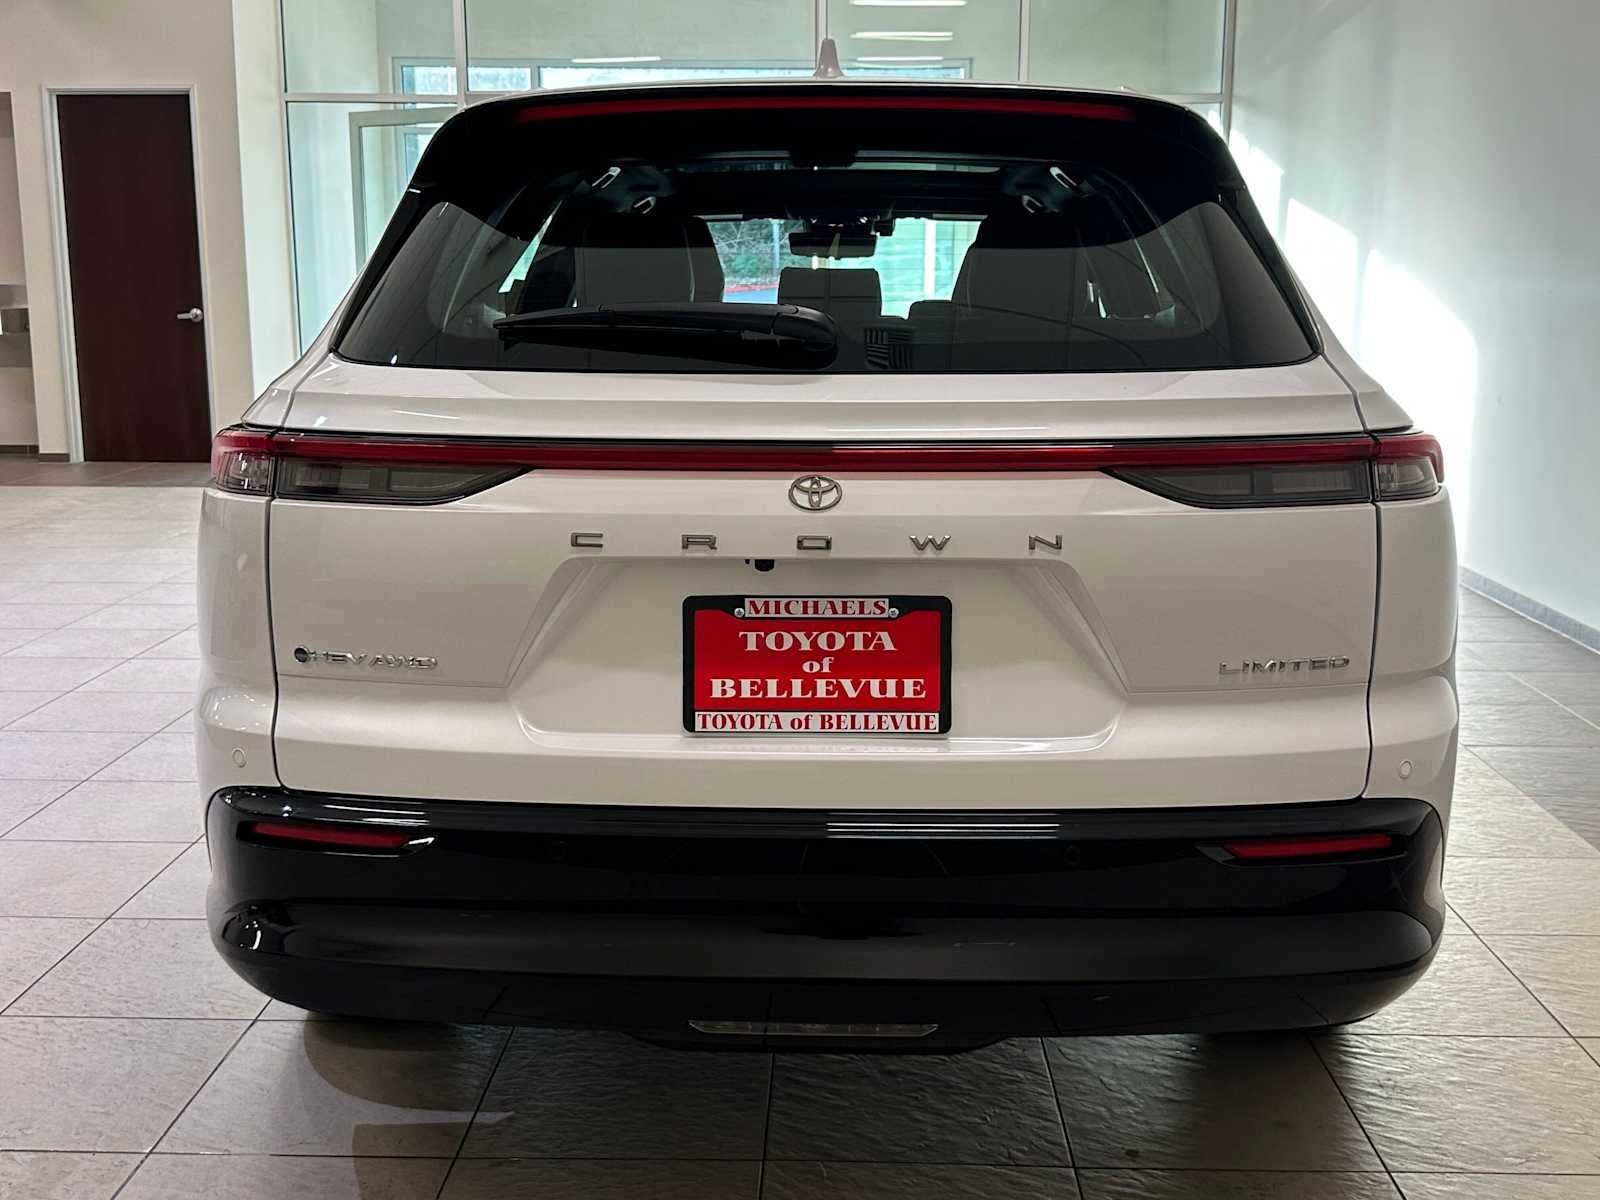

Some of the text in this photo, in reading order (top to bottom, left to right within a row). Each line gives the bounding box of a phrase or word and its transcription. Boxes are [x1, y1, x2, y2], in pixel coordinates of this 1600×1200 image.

[570, 532, 1063, 551] CROWN
[748, 600, 887, 616] MICHAELS
[739, 631, 897, 651] TOYOTA
[802, 656, 834, 674] of
[1219, 656, 1350, 675] LIMITED
[709, 678, 927, 698] BELLEVUE
[697, 713, 937, 731] TOYOTA of BELLEVUE
